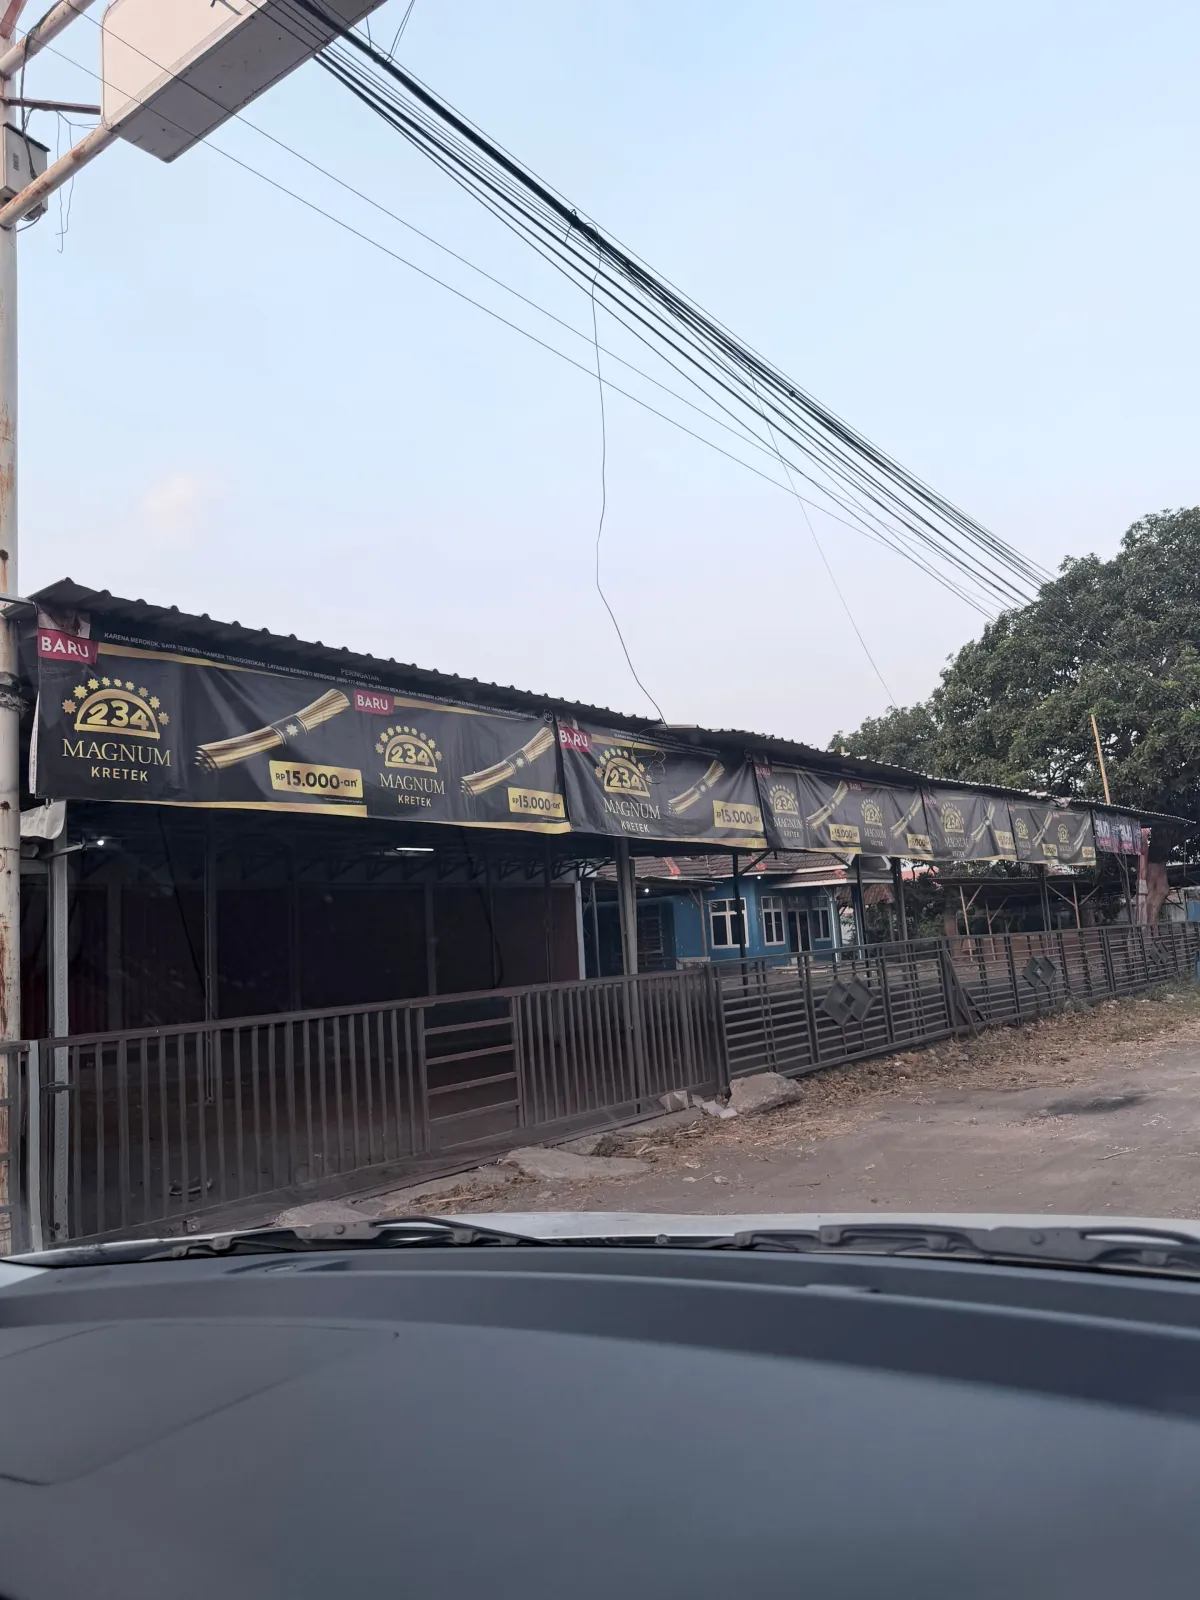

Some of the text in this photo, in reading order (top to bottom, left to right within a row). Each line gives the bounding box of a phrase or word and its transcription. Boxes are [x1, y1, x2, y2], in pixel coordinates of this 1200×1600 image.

[41, 636, 89, 658] BARU
[104, 632, 130, 642] KARENA
[357, 694, 388, 710] BARU
[87, 700, 149, 730] 234
[62, 738, 172, 767] MAGNUM
[391, 743, 430, 766] 234
[91, 766, 148, 782] KRETEK
[379, 772, 446, 795] MAGNUM
[609, 767, 642, 790] 234
[398, 794, 432, 807] KRETEK
[603, 797, 661, 820] MAGNUM
[776, 796, 794, 812] 234
[620, 820, 650, 833] KRETEK
